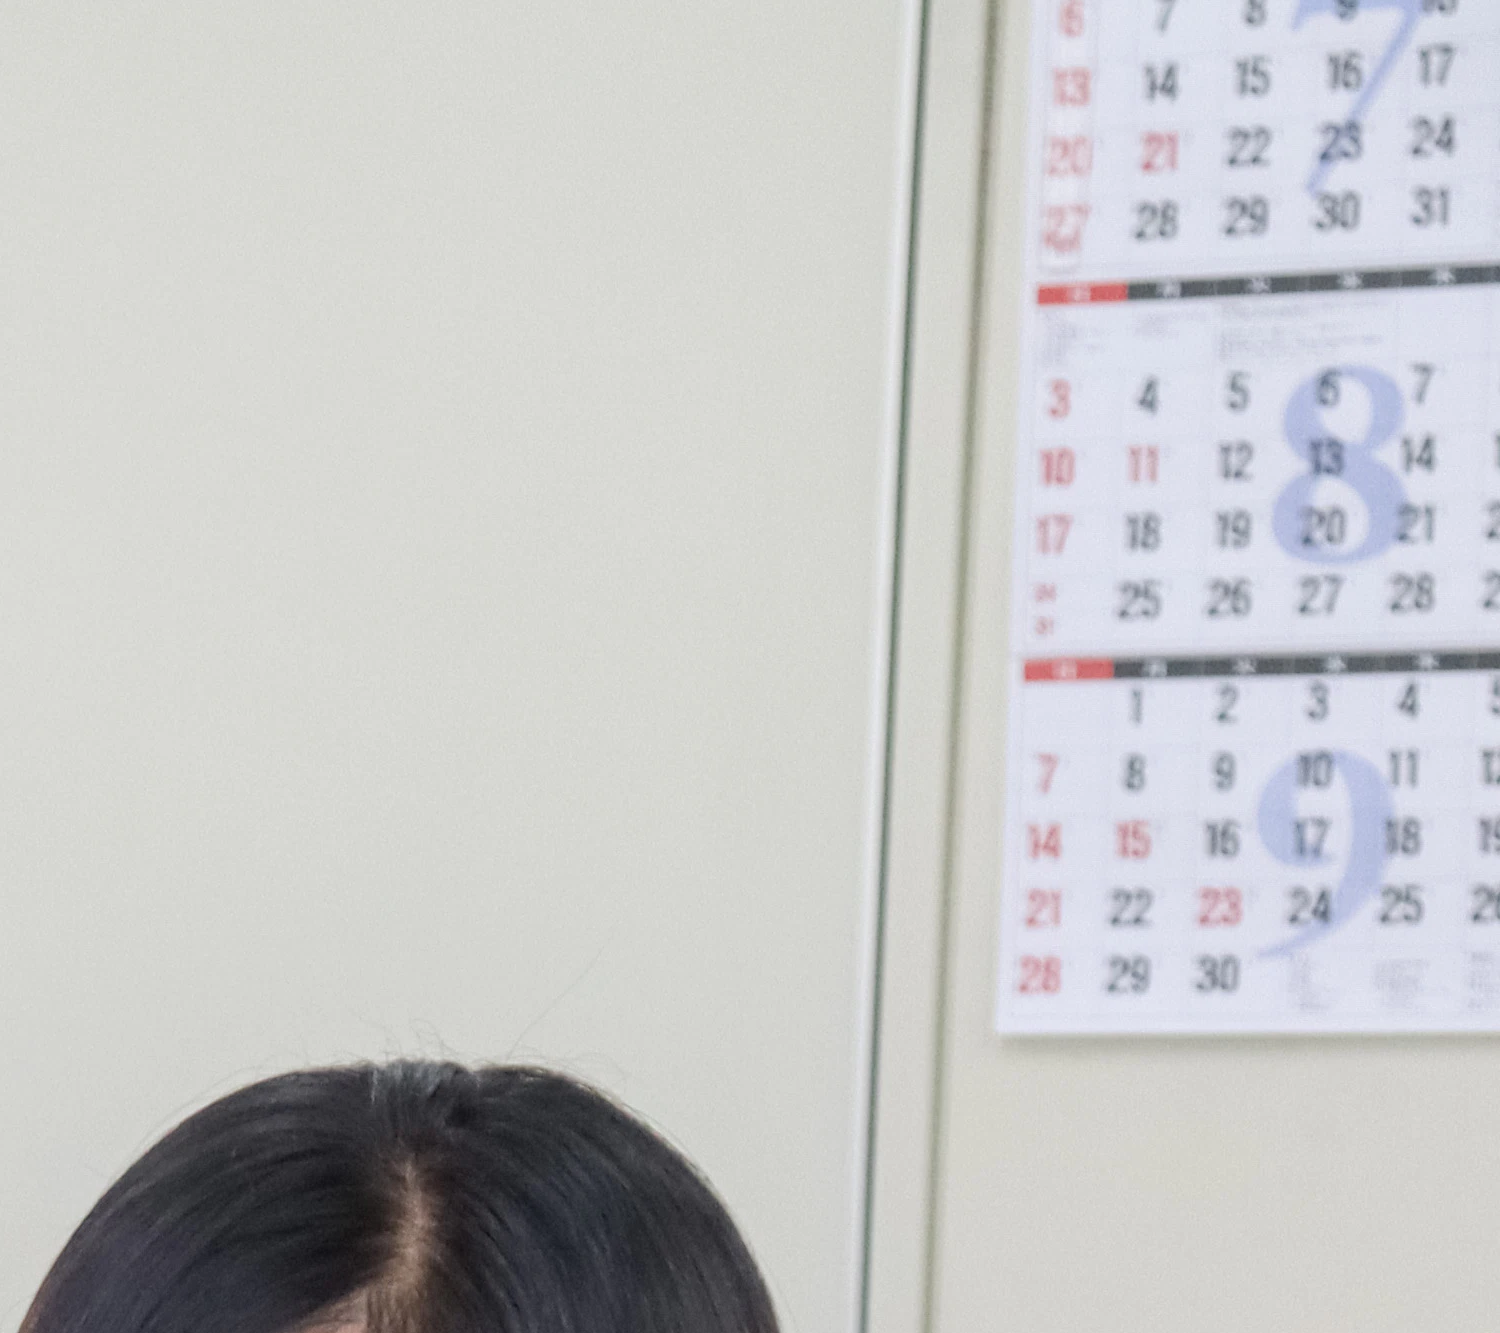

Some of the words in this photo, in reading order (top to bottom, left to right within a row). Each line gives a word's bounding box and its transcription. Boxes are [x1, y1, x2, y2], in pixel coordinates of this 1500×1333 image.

[1155, 0, 1178, 34] 7
[1053, 66, 1092, 107] 13
[1144, 63, 1178, 100] 14
[1235, 55, 1271, 97] 15
[1327, 50, 1363, 91] 16
[1418, 42, 1457, 86] 17
[1140, 131, 1179, 174] 21
[1226, 125, 1272, 168] 22
[1317, 118, 1363, 164] 23
[1410, 116, 1455, 157] 24
[1133, 200, 1179, 242] 28
[1223, 195, 1269, 237] 29
[1313, 190, 1361, 232] 30
[1410, 185, 1450, 227] 31
[1047, 378, 1071, 419] 3
[1137, 377, 1159, 414] 4
[1227, 371, 1250, 412] 5
[1315, 368, 1341, 407] 6
[1411, 362, 1435, 405] 7
[1040, 447, 1075, 486] 10
[1128, 445, 1159, 483] 11
[1219, 440, 1254, 481] 12
[1308, 437, 1345, 477] 13
[1401, 435, 1435, 472] 14
[1035, 512, 1074, 555] 17
[1126, 512, 1161, 551] 18
[1216, 509, 1252, 548] 19
[1300, 506, 1346, 549] 20
[1394, 502, 1436, 544] 21
[1116, 579, 1161, 621] 25
[1206, 578, 1251, 618] 26
[1296, 573, 1344, 617] 27
[1388, 572, 1435, 614] 28
[1130, 682, 1144, 724] 1
[1215, 681, 1239, 724] 2
[1306, 678, 1329, 721] 3
[1397, 681, 1419, 717] 4
[1036, 752, 1060, 795] 7
[1123, 754, 1145, 792] 8
[1212, 752, 1236, 791] 9
[1296, 750, 1334, 788] 10
[1388, 748, 1419, 788] 11
[1028, 823, 1062, 859] 14
[1116, 819, 1152, 860] 15
[1205, 819, 1240, 858] 16
[1292, 816, 1331, 859] 17
[1384, 817, 1421, 856] 18
[1024, 888, 1062, 929] 21
[1108, 887, 1153, 928] 22
[1197, 886, 1243, 927] 23
[1288, 887, 1332, 925] 24
[1378, 884, 1423, 925] 25
[1017, 955, 1061, 994] 28
[1105, 955, 1151, 994] 29
[1195, 954, 1240, 993] 30
